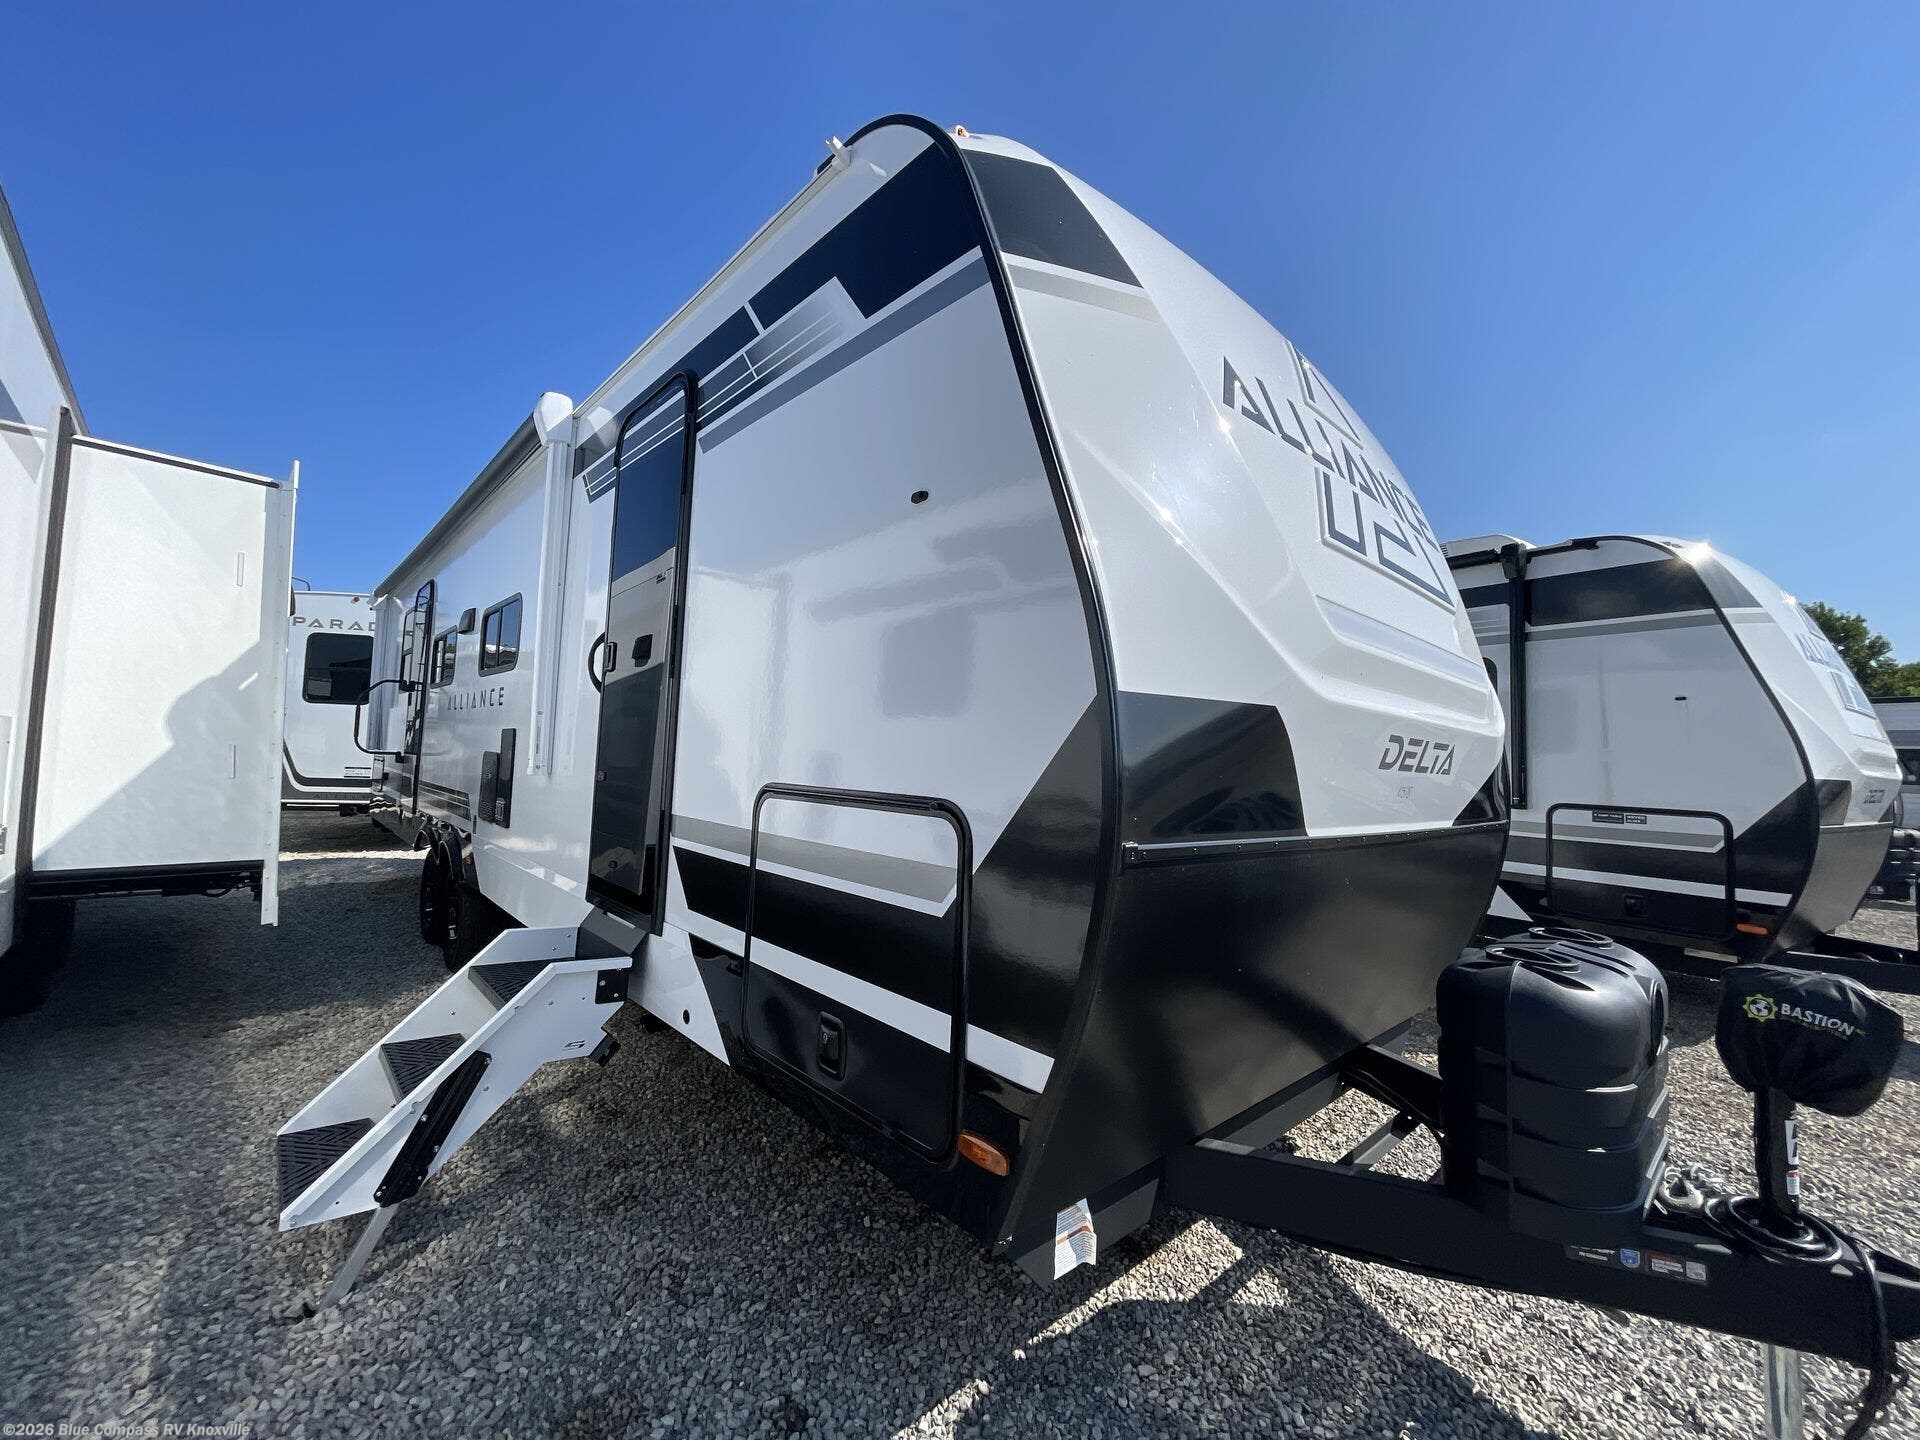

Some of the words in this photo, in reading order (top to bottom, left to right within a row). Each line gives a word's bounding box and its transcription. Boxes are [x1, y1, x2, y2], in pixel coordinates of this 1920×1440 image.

[1222, 355, 1440, 553] ALLIANCE
[447, 686, 506, 711] ALLIANCE
[1378, 734, 1455, 775] DELTA
[1780, 1003, 1855, 1036] BASTION
